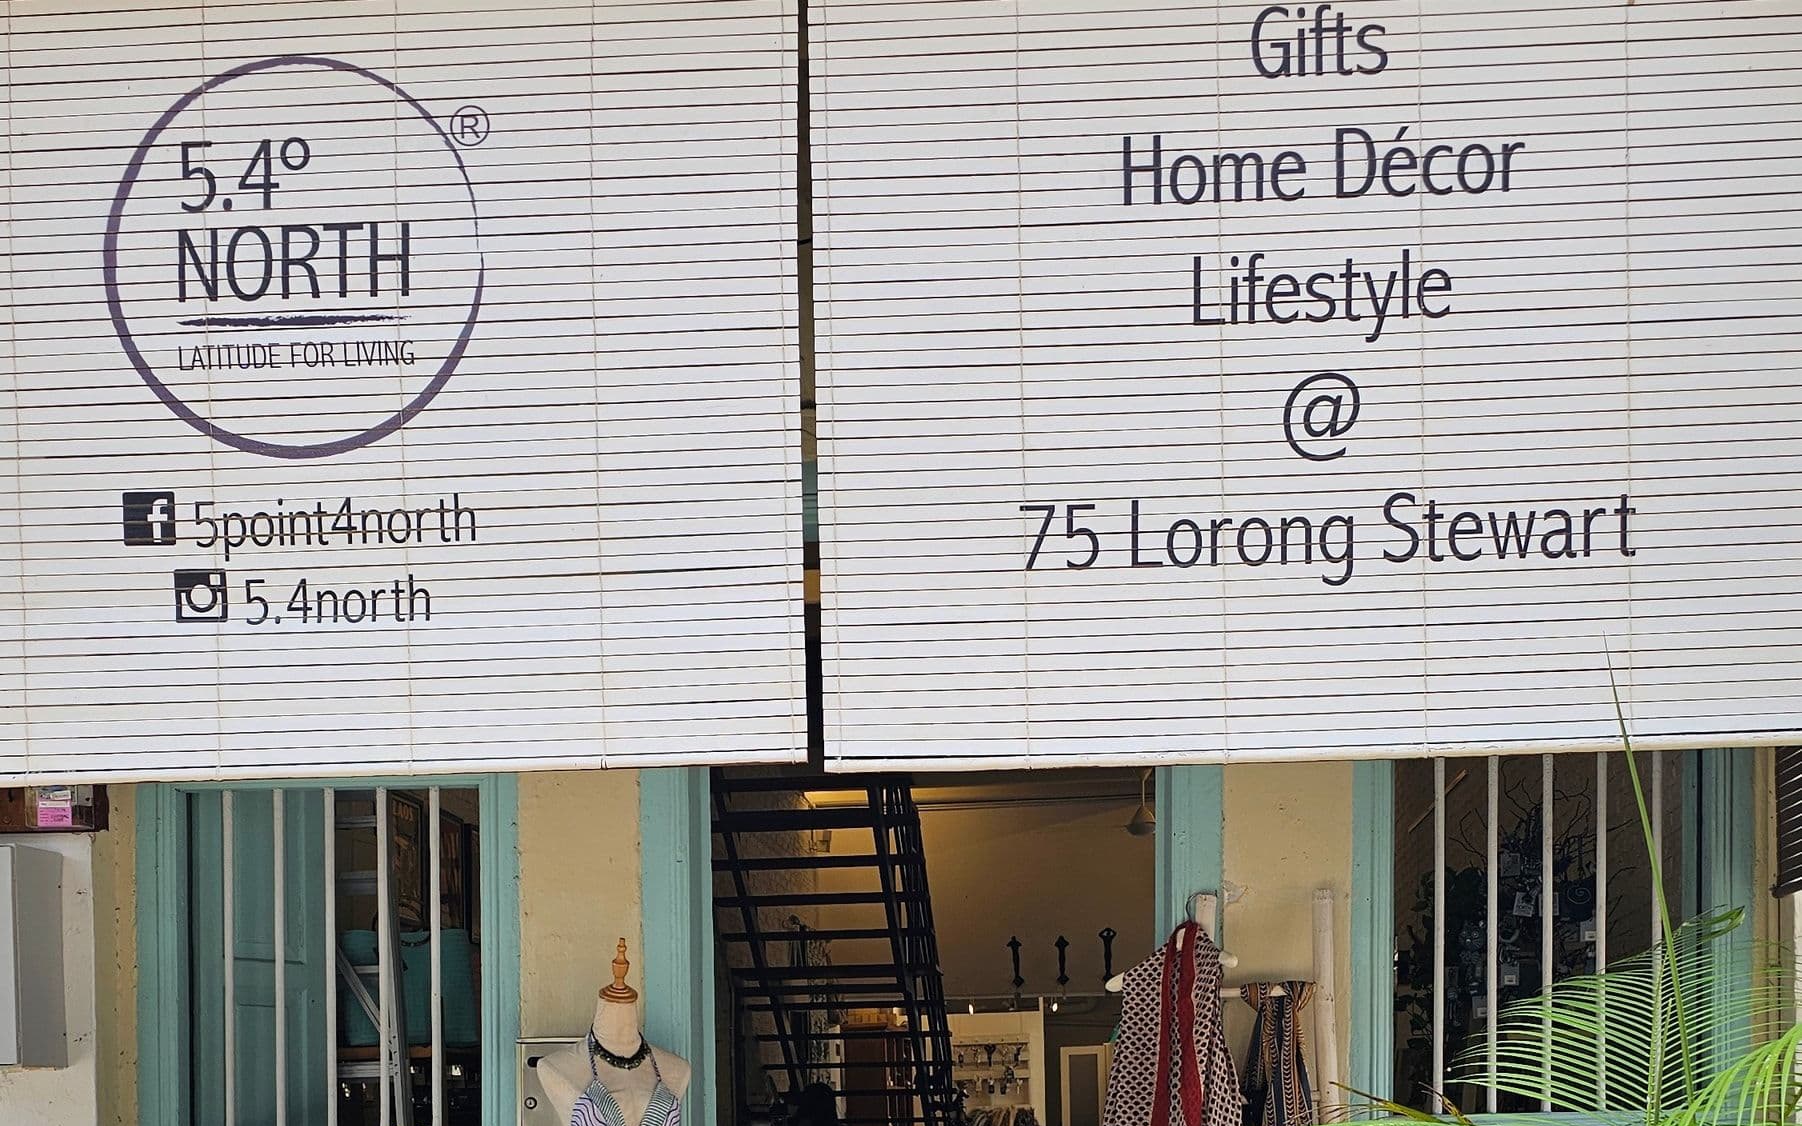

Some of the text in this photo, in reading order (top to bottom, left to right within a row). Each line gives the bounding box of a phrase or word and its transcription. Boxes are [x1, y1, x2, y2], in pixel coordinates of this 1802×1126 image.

[1251, 4, 1389, 78] Gifts
[1123, 126, 1525, 206] Home Décor
[178, 222, 411, 303] NORTH
[1193, 249, 1452, 343] Lifestyle
[178, 340, 415, 371] LATITUDE FOR LIVING
[1283, 372, 1361, 462] @
[195, 493, 477, 562] 5point4north
[1019, 492, 1637, 586] 75 Lorong Stewart
[245, 574, 431, 625] 5.4north
